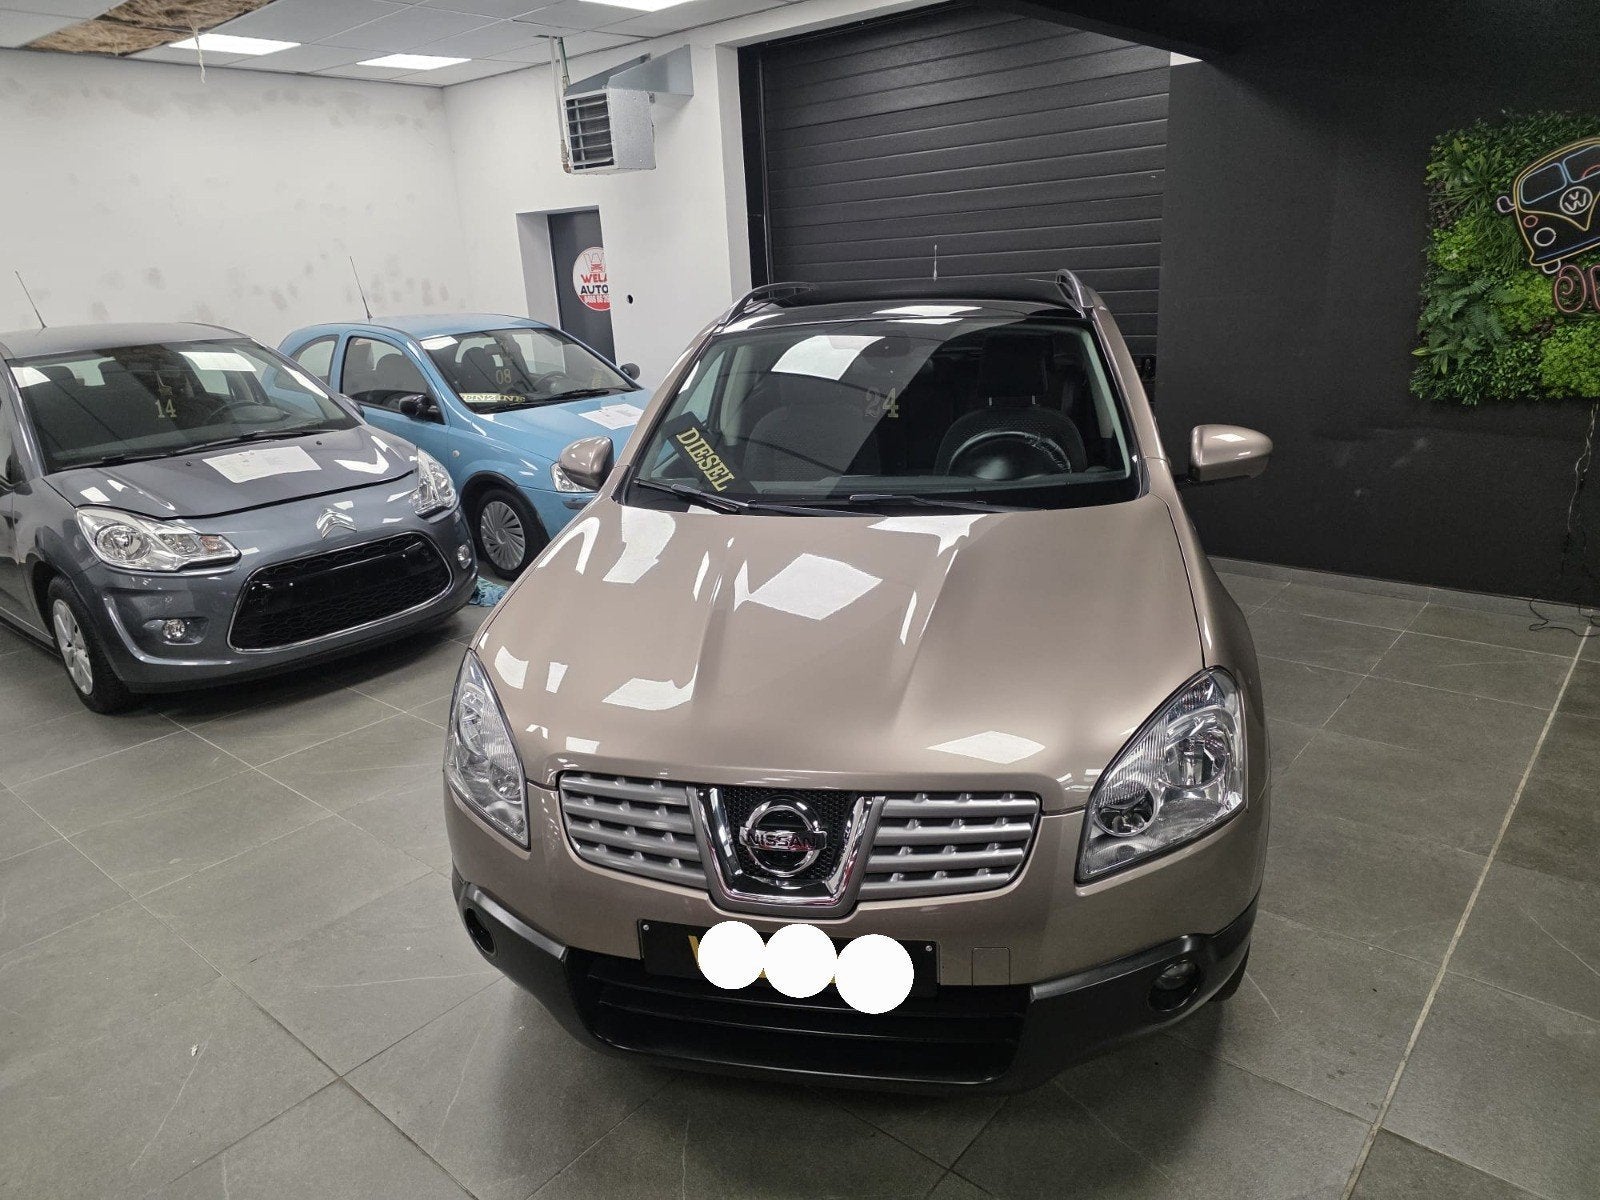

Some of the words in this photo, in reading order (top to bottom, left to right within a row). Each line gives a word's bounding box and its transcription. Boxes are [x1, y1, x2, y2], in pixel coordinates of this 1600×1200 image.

[580, 284, 609, 294] AUTO
[495, 368, 512, 385] 08
[155, 398, 177, 418] 14
[676, 427, 735, 492] DIESEL
[747, 829, 816, 850] NISSAN
